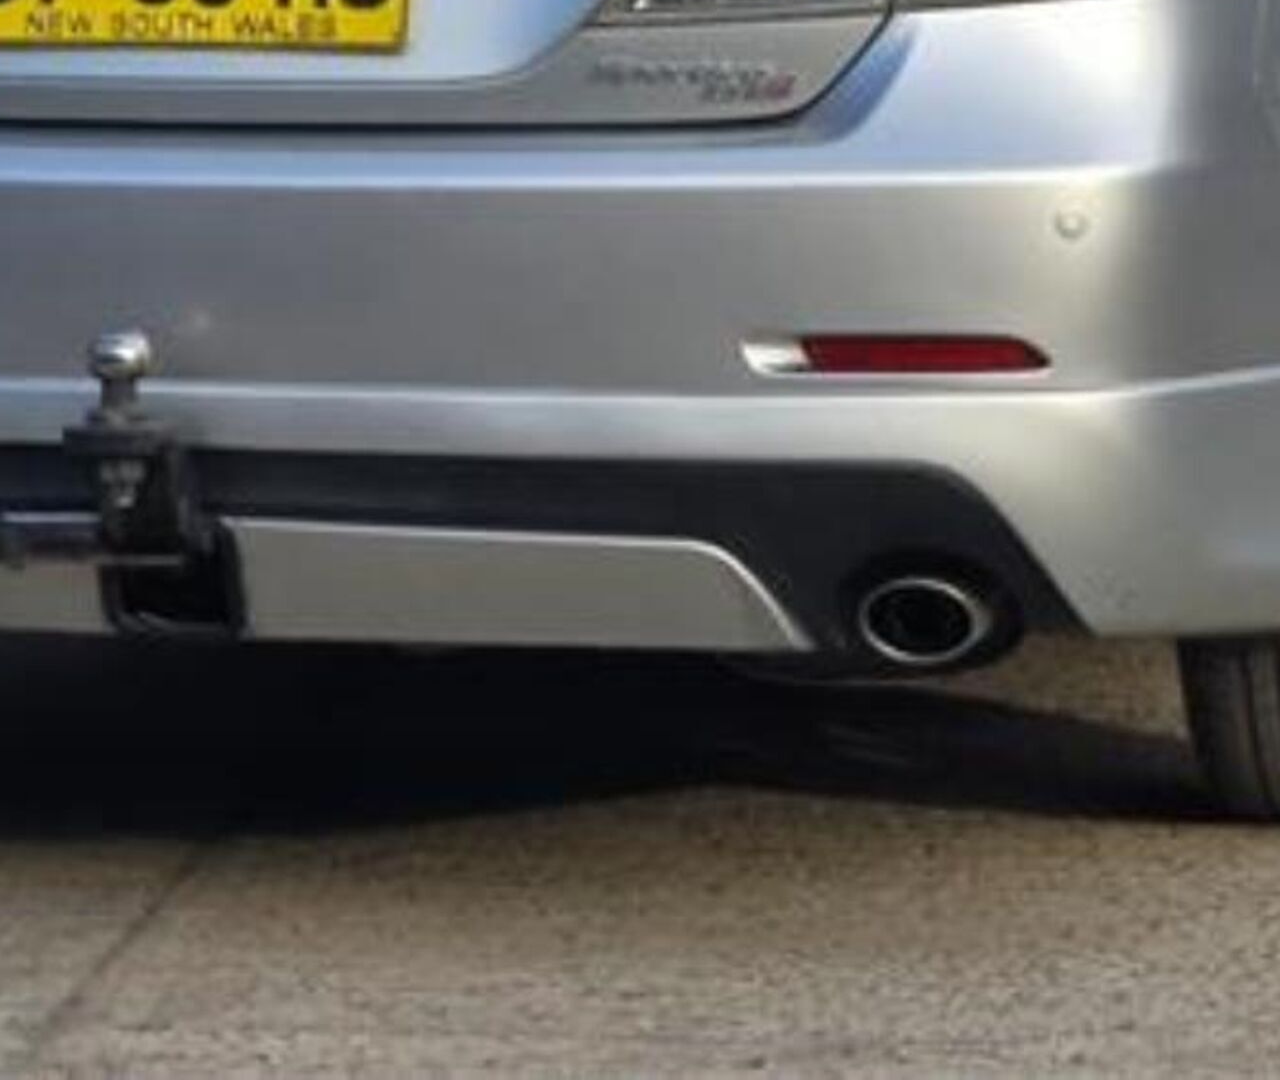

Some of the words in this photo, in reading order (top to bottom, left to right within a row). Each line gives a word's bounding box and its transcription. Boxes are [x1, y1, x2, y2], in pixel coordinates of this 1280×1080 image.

[25, 12, 93, 34] NEW
[116, 12, 213, 35] SOUTH
[234, 13, 339, 38] WALES
